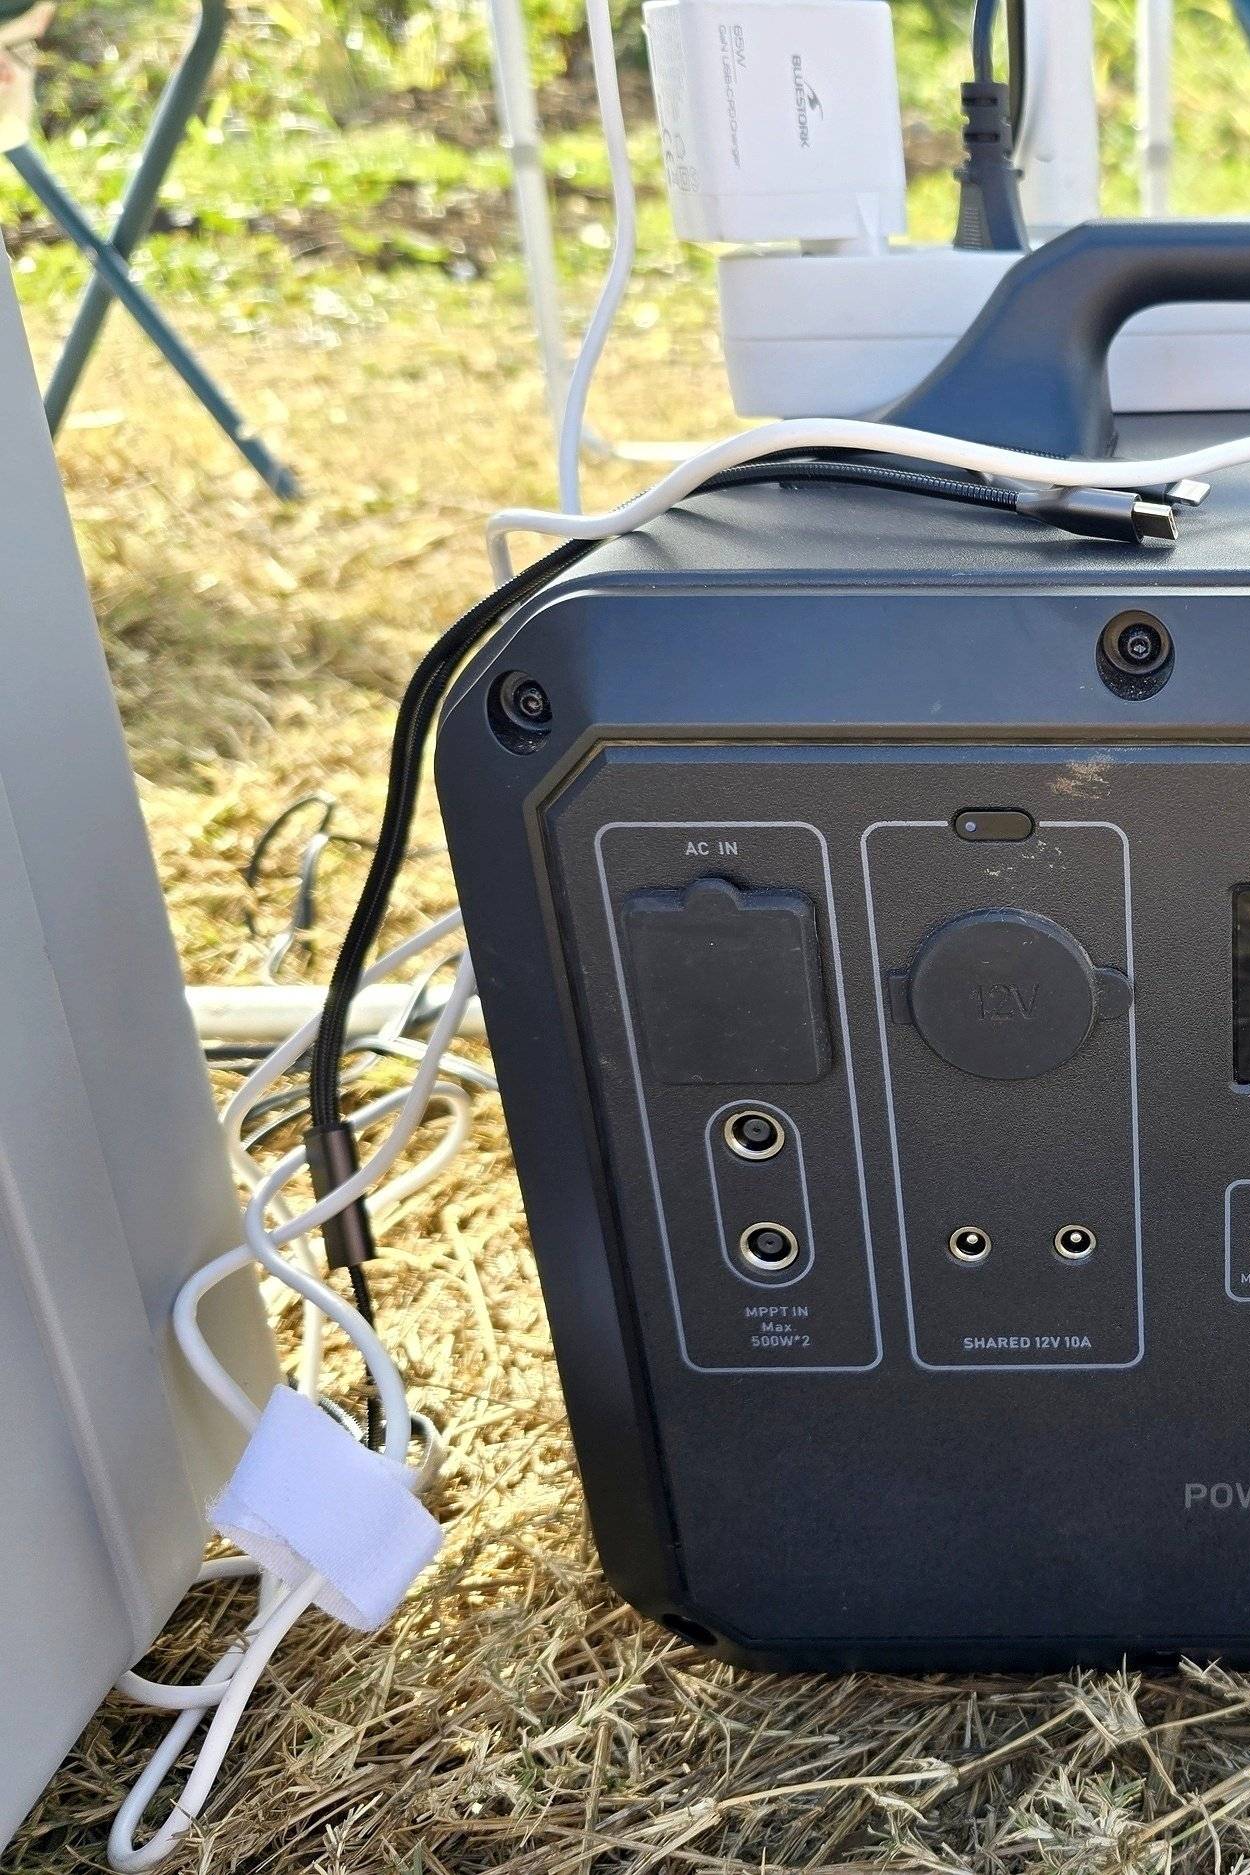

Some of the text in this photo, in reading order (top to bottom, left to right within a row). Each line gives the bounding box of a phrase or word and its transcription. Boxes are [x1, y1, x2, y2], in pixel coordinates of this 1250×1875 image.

[791, 54, 811, 149] BLUESTORK
[685, 841, 738, 856] AC IN
[975, 983, 1040, 1022] 12V
[744, 1305, 809, 1318] MPPT IN
[963, 1335, 1092, 1350] SHARED 12V 10A
